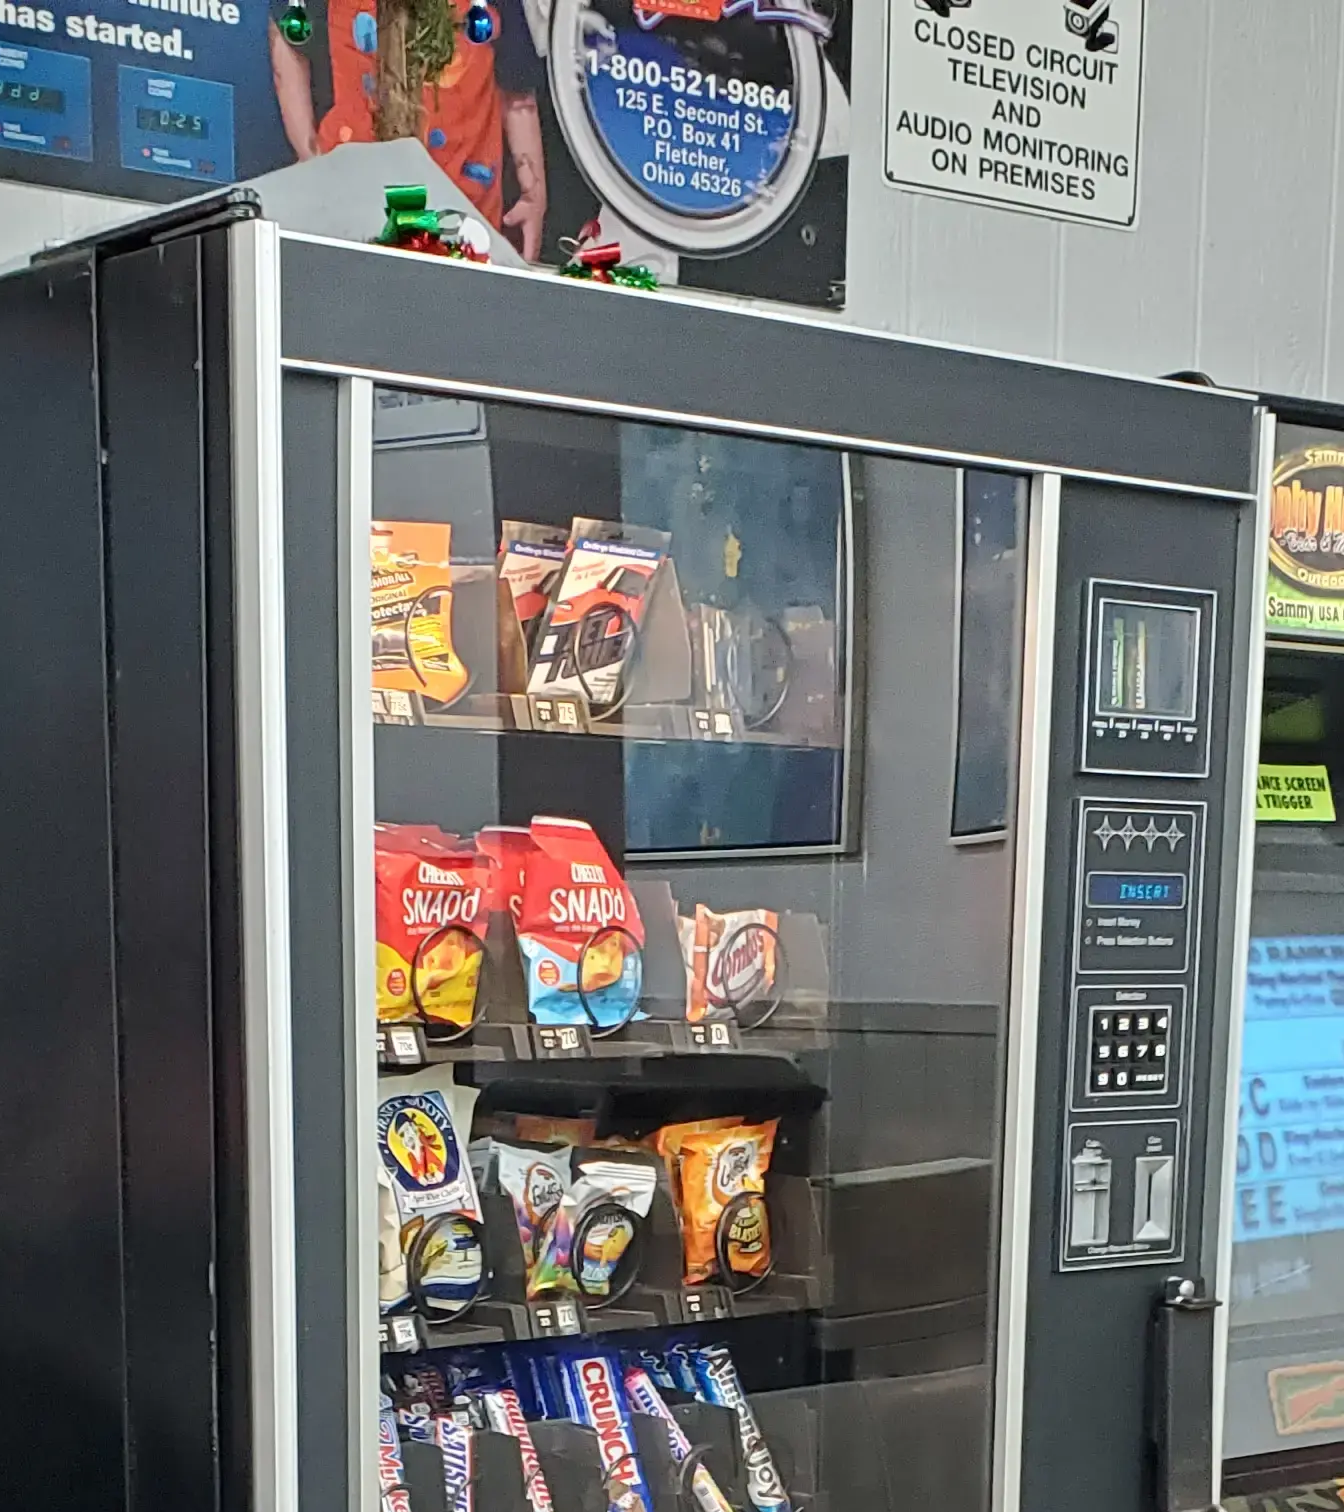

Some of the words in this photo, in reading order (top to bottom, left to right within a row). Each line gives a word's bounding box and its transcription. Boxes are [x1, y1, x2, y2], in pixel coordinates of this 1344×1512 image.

[66, 14, 194, 61] started.
[914, 18, 1016, 61] CLOSED
[1026, 44, 1119, 85] CIRCUIT
[586, 49, 792, 115] 1-800-521-9864
[947, 57, 1086, 110] TELEVISION
[616, 87, 647, 111] 125
[652, 94, 669, 116] E.
[674, 98, 740, 130] Second
[744, 113, 769, 136] St.
[991, 98, 1042, 129] AND
[643, 115, 677, 141] P.O.
[682, 123, 716, 149] Box
[720, 132, 741, 152] 41
[896, 110, 973, 146] AUDIO
[983, 127, 1129, 178] MONITORING
[655, 140, 730, 175] Fletcher,
[932, 149, 967, 176] ON
[979, 157, 1096, 201] PREMISES
[642, 161, 686, 188] Ohio
[690, 170, 742, 197] 45326
[1271, 479, 1323, 539] phy
[1268, 596, 1315, 623] Sammy
[1319, 606, 1339, 622] USA
[1265, 794, 1314, 810] TRIGGER
[1284, 777, 1327, 793] SCREEN
[549, 888, 626, 927] SNAP'd
[1119, 883, 1171, 900] INSERT
[1100, 1017, 1109, 1030] 1
[1117, 1018, 1130, 1031] 2
[1137, 1017, 1150, 1030] 3
[1156, 1016, 1168, 1029] 4
[1098, 1045, 1110, 1058] 5
[1117, 1045, 1129, 1058] 6
[1136, 1044, 1148, 1058] 7
[1154, 1044, 1166, 1057] 8
[1097, 1072, 1109, 1086] 9
[1116, 1071, 1128, 1085] 0
[581, 1361, 642, 1486] CRUNCH
